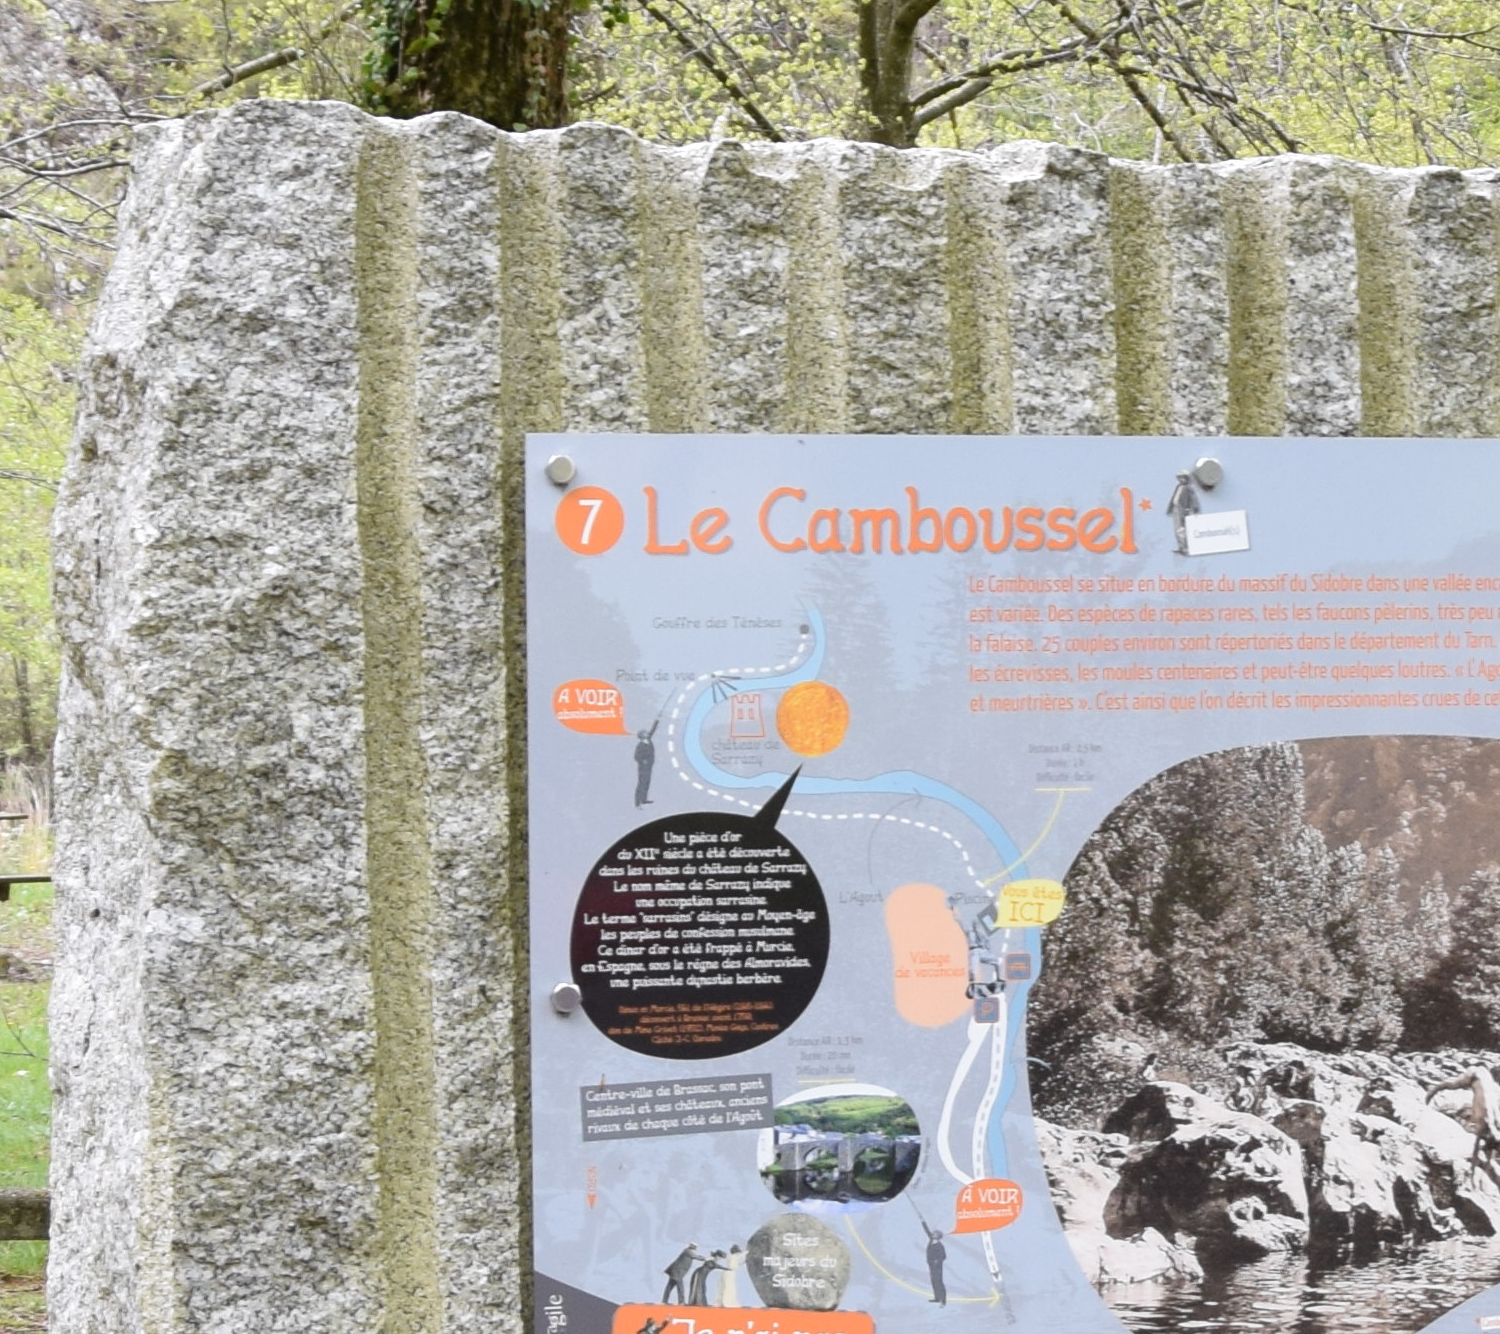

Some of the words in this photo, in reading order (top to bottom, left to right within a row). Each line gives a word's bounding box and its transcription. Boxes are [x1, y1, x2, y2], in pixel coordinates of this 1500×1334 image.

[577, 499, 604, 545] 7
[642, 485, 733, 556] Le
[758, 485, 1139, 555] Camboussel
[968, 574, 985, 593] Le
[987, 574, 1075, 592] Camboussel
[1077, 579, 1094, 592] se
[1098, 576, 1134, 592] situe
[1136, 579, 1155, 592] en
[1157, 574, 1214, 592] bordure
[1216, 574, 1236, 592] du
[1238, 574, 1286, 592] massif
[1289, 574, 1307, 592] du
[1310, 574, 1363, 592] Sidobre
[1365, 574, 1400, 592] dans
[1402, 579, 1429, 592] une
[1431, 574, 1472, 592] vallée
[706, 616, 728, 628] des
[968, 606, 994, 622] est
[995, 605, 1041, 622] variée.
[1045, 604, 1074, 622] Des
[1076, 605, 1135, 626] espèces
[1138, 603, 1157, 621] de
[1159, 608, 1214, 625] rapaces
[1218, 608, 1256, 622] rares,
[1260, 603, 1288, 621] tels
[1290, 602, 1313, 621] les
[1315, 602, 1370, 620] faucons
[1373, 602, 1431, 624] pèlerins,
[1435, 603, 1465, 620] très
[1467, 607, 1493, 624] peu
[968, 634, 982, 652] la
[985, 634, 1035, 652] falaise.
[1040, 638, 1061, 656] 25
[1064, 633, 1119, 655] couples
[1122, 634, 1176, 651] environ
[1178, 634, 1212, 650] sont
[1215, 633, 1293, 654] répertoriés
[1295, 631, 1330, 650] dans
[1333, 631, 1346, 649] le
[1349, 631, 1440, 653] département
[1442, 630, 1461, 648] du
[1463, 630, 1495, 648] Tarn.
[654, 668, 670, 681] de
[675, 670, 696, 681] vue
[575, 688, 618, 706] VOIR
[662, 831, 687, 843] Une
[1032, 884, 1062, 899] êtes
[1010, 900, 1045, 924] ICI
[978, 1188, 1019, 1204] VOIR
[782, 1232, 819, 1247] Sites
[762, 1253, 817, 1270] majeurs
[819, 1253, 837, 1268] du
[772, 1272, 826, 1289] Sidobre
